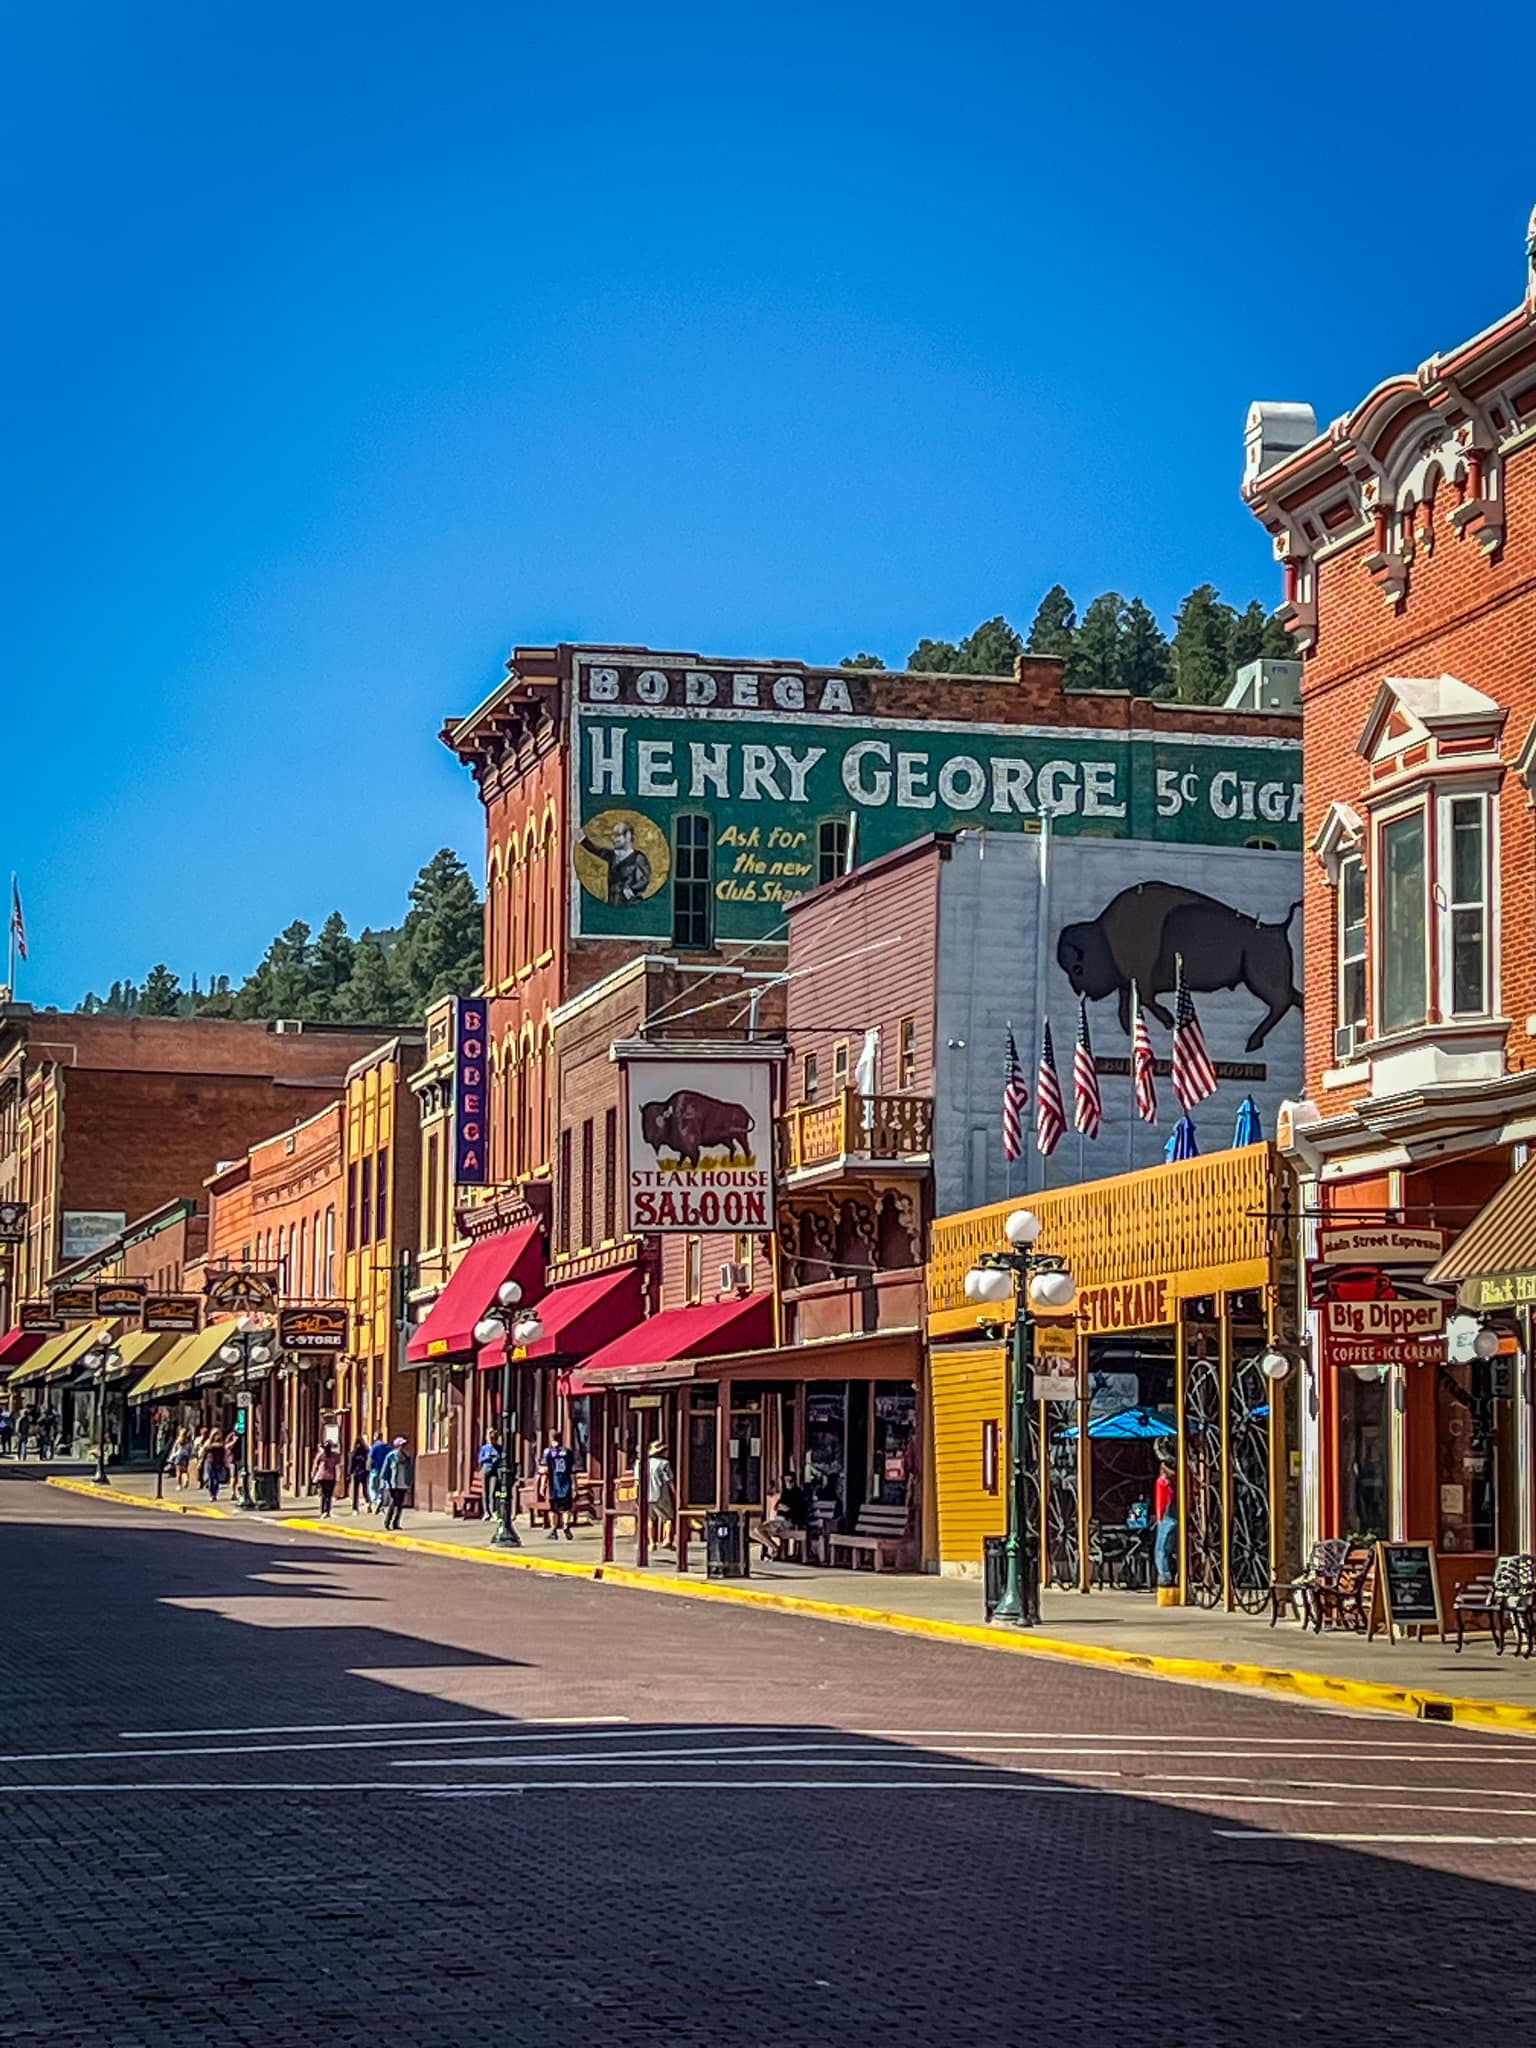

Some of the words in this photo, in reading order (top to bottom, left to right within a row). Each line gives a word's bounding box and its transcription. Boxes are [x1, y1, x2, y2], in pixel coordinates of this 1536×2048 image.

[589, 667, 853, 713] BODEGA
[587, 727, 827, 803] HENRY
[841, 740, 1127, 818] GEORGE
[1155, 763, 1201, 817] 5¢
[716, 825, 760, 847] Ask
[767, 826, 807, 848] for
[732, 852, 768, 874] the
[768, 861, 813, 877] new
[715, 879, 757, 901] Club
[463, 1010, 482, 1171] BODEGA
[631, 1170, 769, 1188] STEAKHOUSE
[633, 1189, 768, 1226] SALOON
[1325, 1238, 1351, 1253] Main
[1352, 1233, 1389, 1249] Street
[1390, 1233, 1442, 1250] Espresso
[1480, 1278, 1515, 1304] Black
[1078, 1278, 1168, 1332] STOCKADE
[1333, 1303, 1365, 1333] Big
[1368, 1303, 1438, 1333] Dipper
[1332, 1346, 1376, 1362] COFFEE
[1382, 1346, 1401, 1361] ICE
[1403, 1344, 1442, 1361] CREAM
